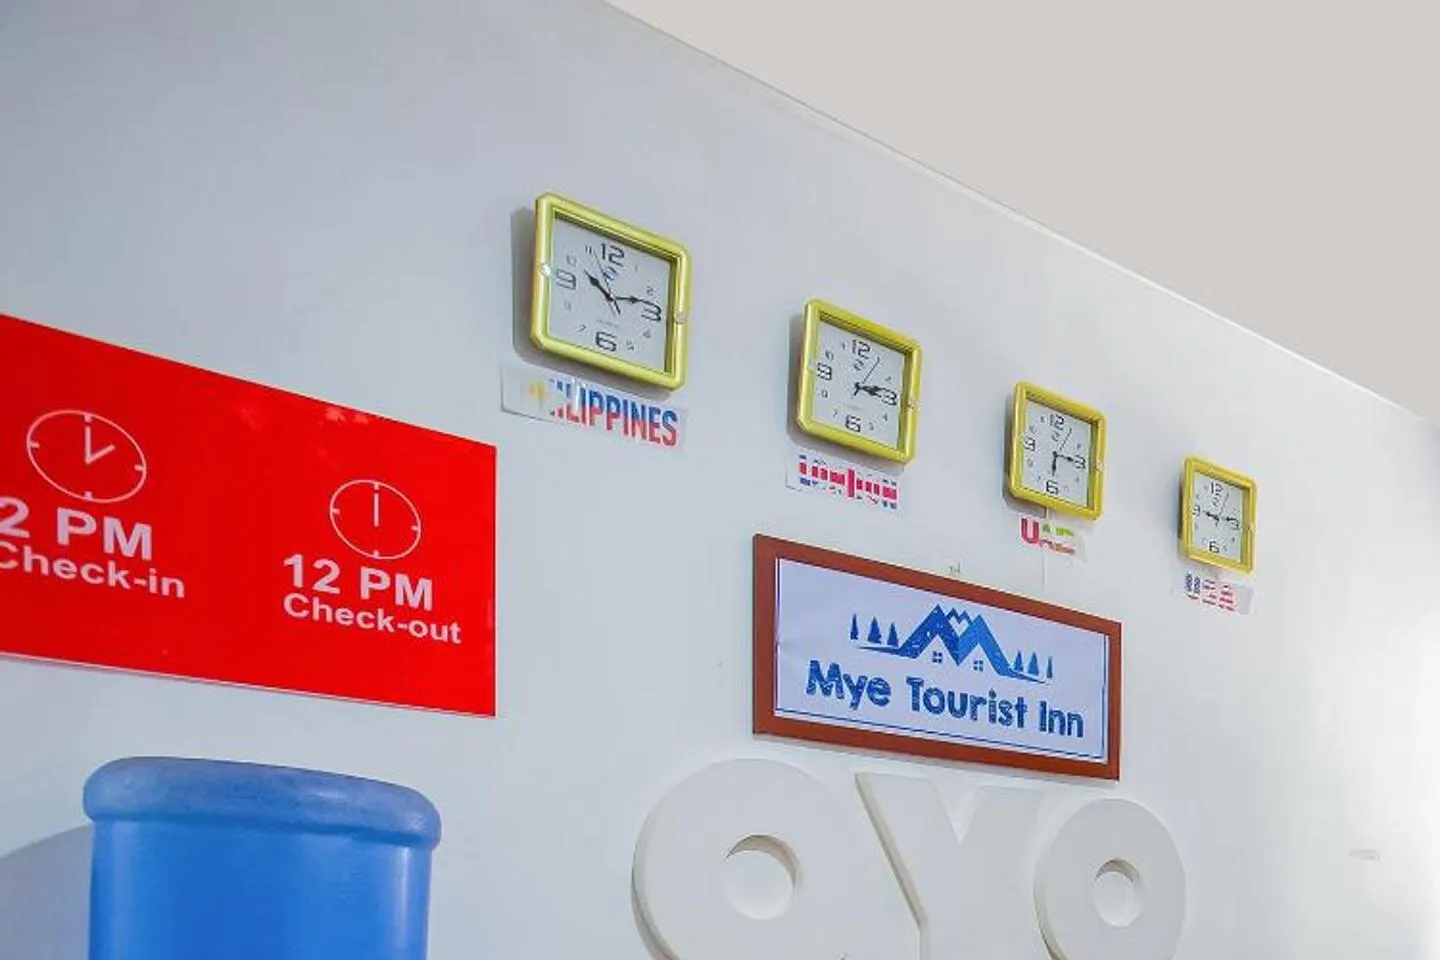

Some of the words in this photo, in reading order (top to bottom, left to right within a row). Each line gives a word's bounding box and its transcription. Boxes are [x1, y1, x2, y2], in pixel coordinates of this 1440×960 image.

[601, 243, 624, 267] 12
[641, 301, 661, 321] 3
[596, 332, 617, 351] 6
[523, 372, 678, 447] ILIPPINES
[0, 496, 30, 538] 2
[57, 506, 152, 561] PM
[0, 540, 185, 599] Check-in
[283, 554, 341, 595] 12
[360, 566, 433, 612] PM
[283, 592, 462, 645] Check-out
[806, 660, 891, 711] Mye
[906, 677, 1028, 729] Tourist
[1039, 700, 1084, 739] Inn
